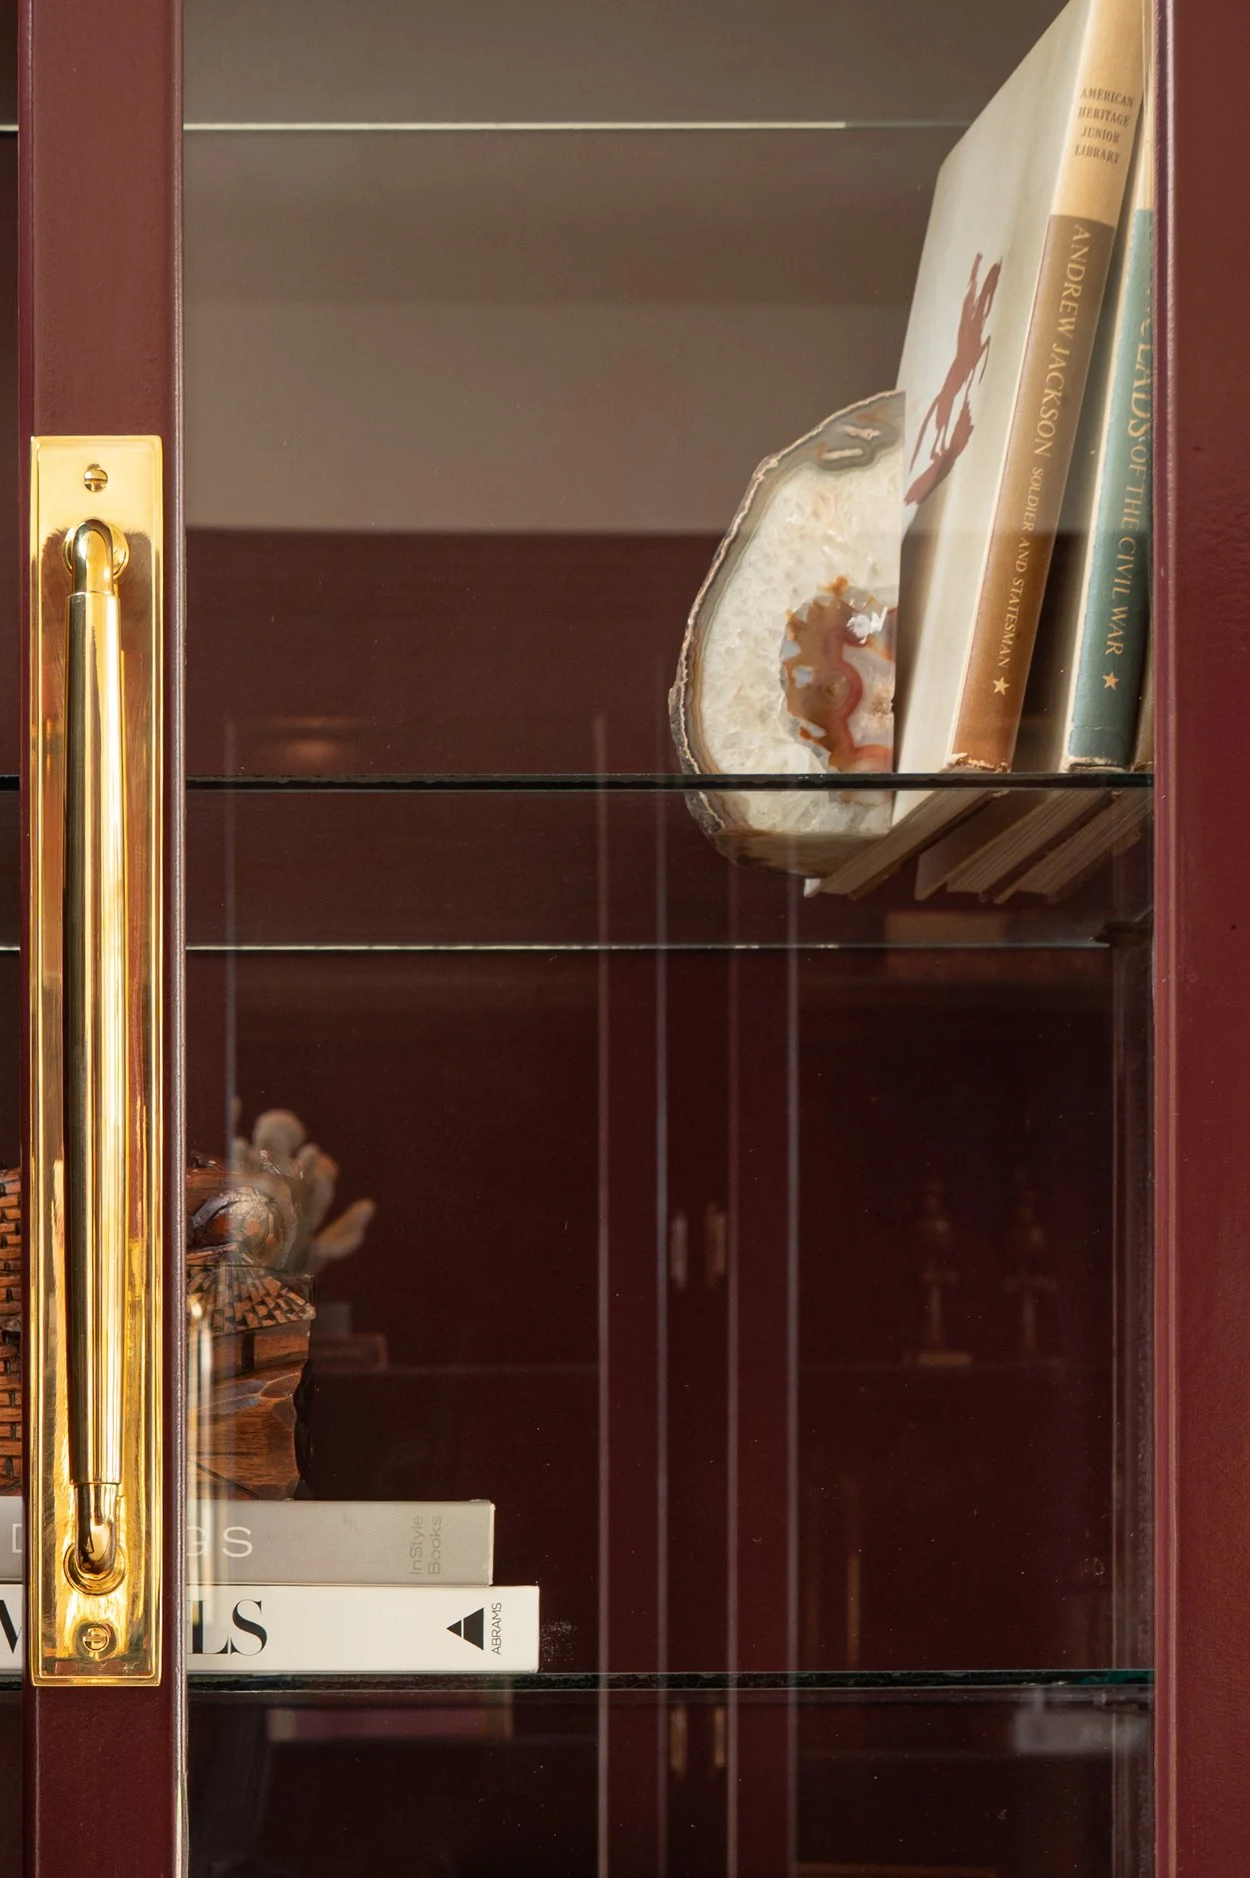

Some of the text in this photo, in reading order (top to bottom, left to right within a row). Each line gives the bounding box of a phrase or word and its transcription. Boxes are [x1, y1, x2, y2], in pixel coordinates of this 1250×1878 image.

[1078, 106, 1130, 127] HERITAGE
[1081, 88, 1134, 108] AMERICAN
[1075, 144, 1121, 164] LIBRARY
[1081, 126, 1120, 144] JUNIOR
[997, 224, 1092, 669] ANDREW JACKSON SOLDIER AND STATESMAN
[1129, 445, 1147, 479] OF
[1122, 480, 1146, 530] THE
[1112, 536, 1136, 599] CIVIL
[1105, 606, 1129, 656] WAR
[410, 1515, 425, 1575] InStyle
[428, 1515, 442, 1575] Books
[491, 1602, 502, 1655] ABRAMS
